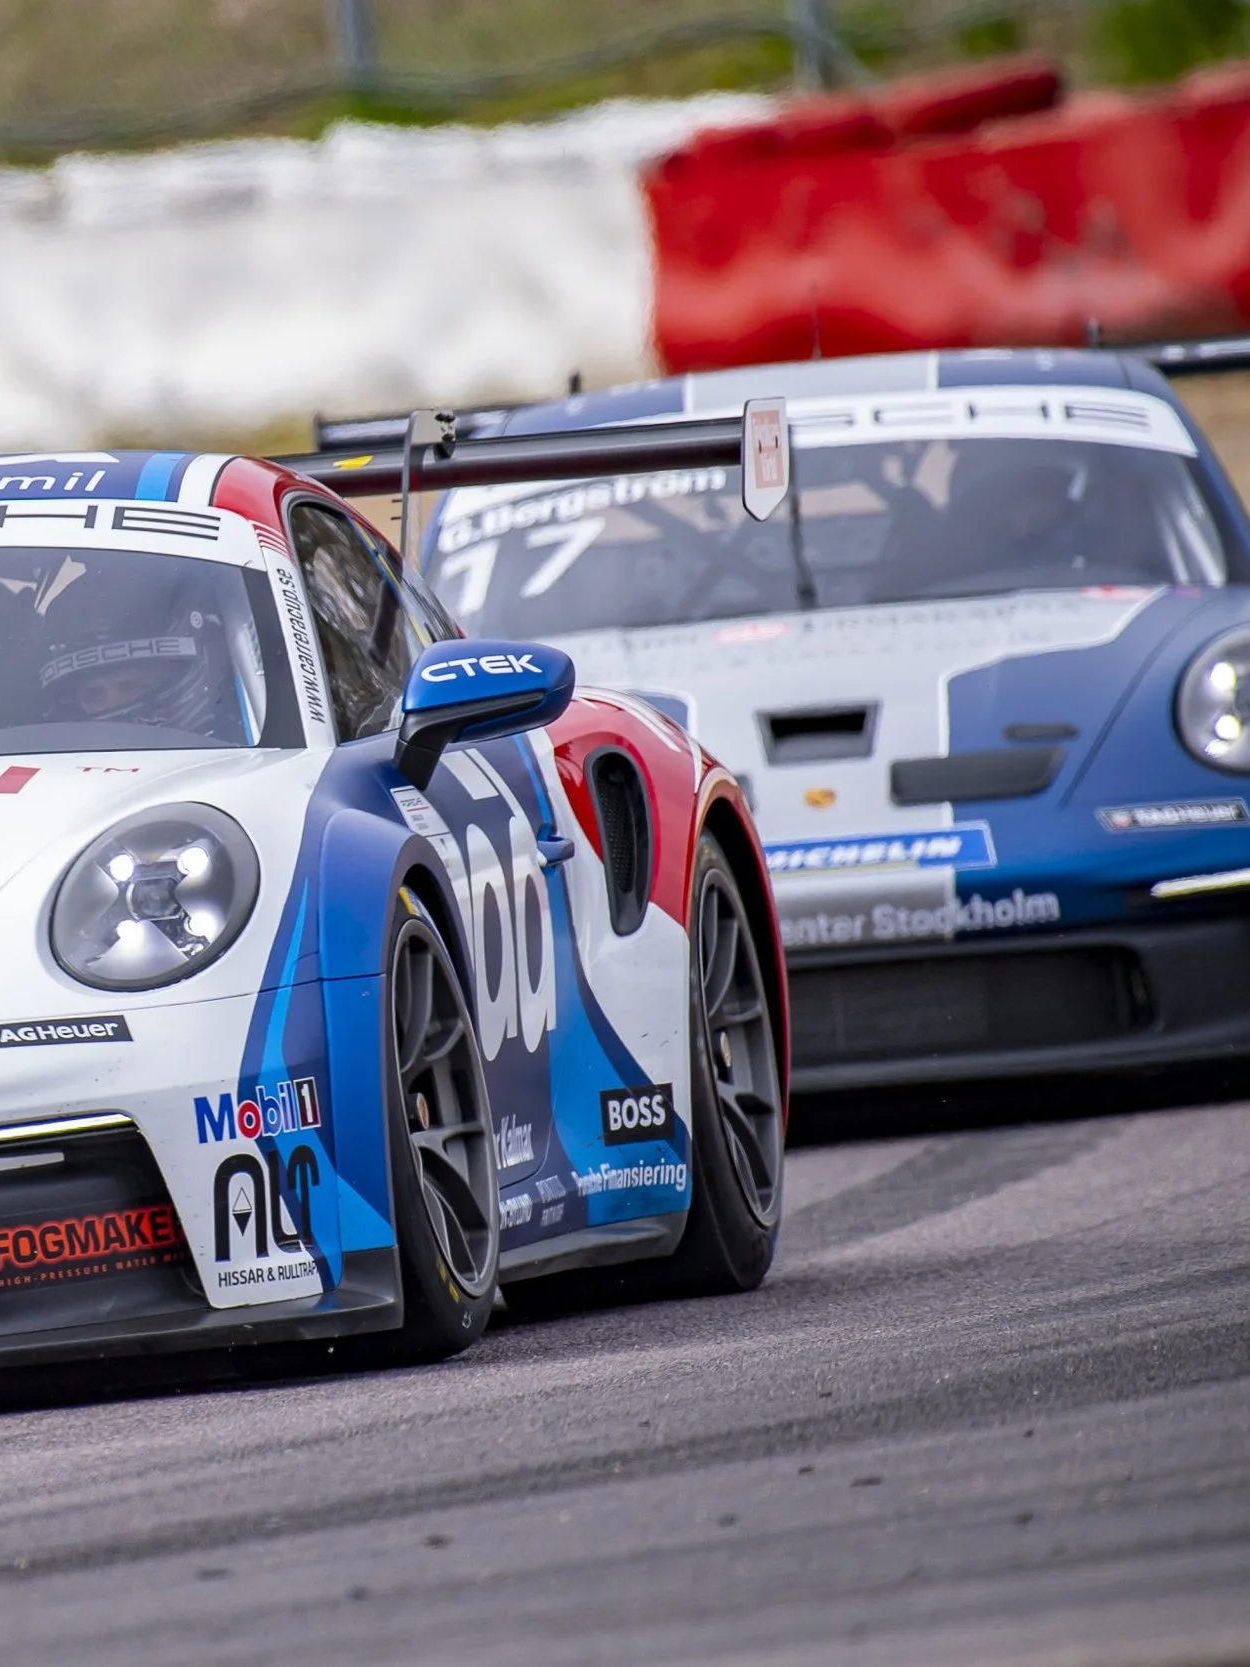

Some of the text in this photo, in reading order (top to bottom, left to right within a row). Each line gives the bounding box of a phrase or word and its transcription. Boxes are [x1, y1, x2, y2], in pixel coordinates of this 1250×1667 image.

[440, 515, 607, 617] 17
[41, 637, 182, 683] ORSCHE
[276, 567, 326, 724] www.carreracup.se
[420, 653, 544, 683] CTEK
[780, 887, 1061, 947] enter Stockholm
[193, 1084, 297, 1144] Mobil
[607, 1094, 667, 1131] BOSS
[601, 1158, 687, 1193] Finansiering
[218, 1268, 266, 1287] HISSAR
[267, 1267, 276, 1281] &
